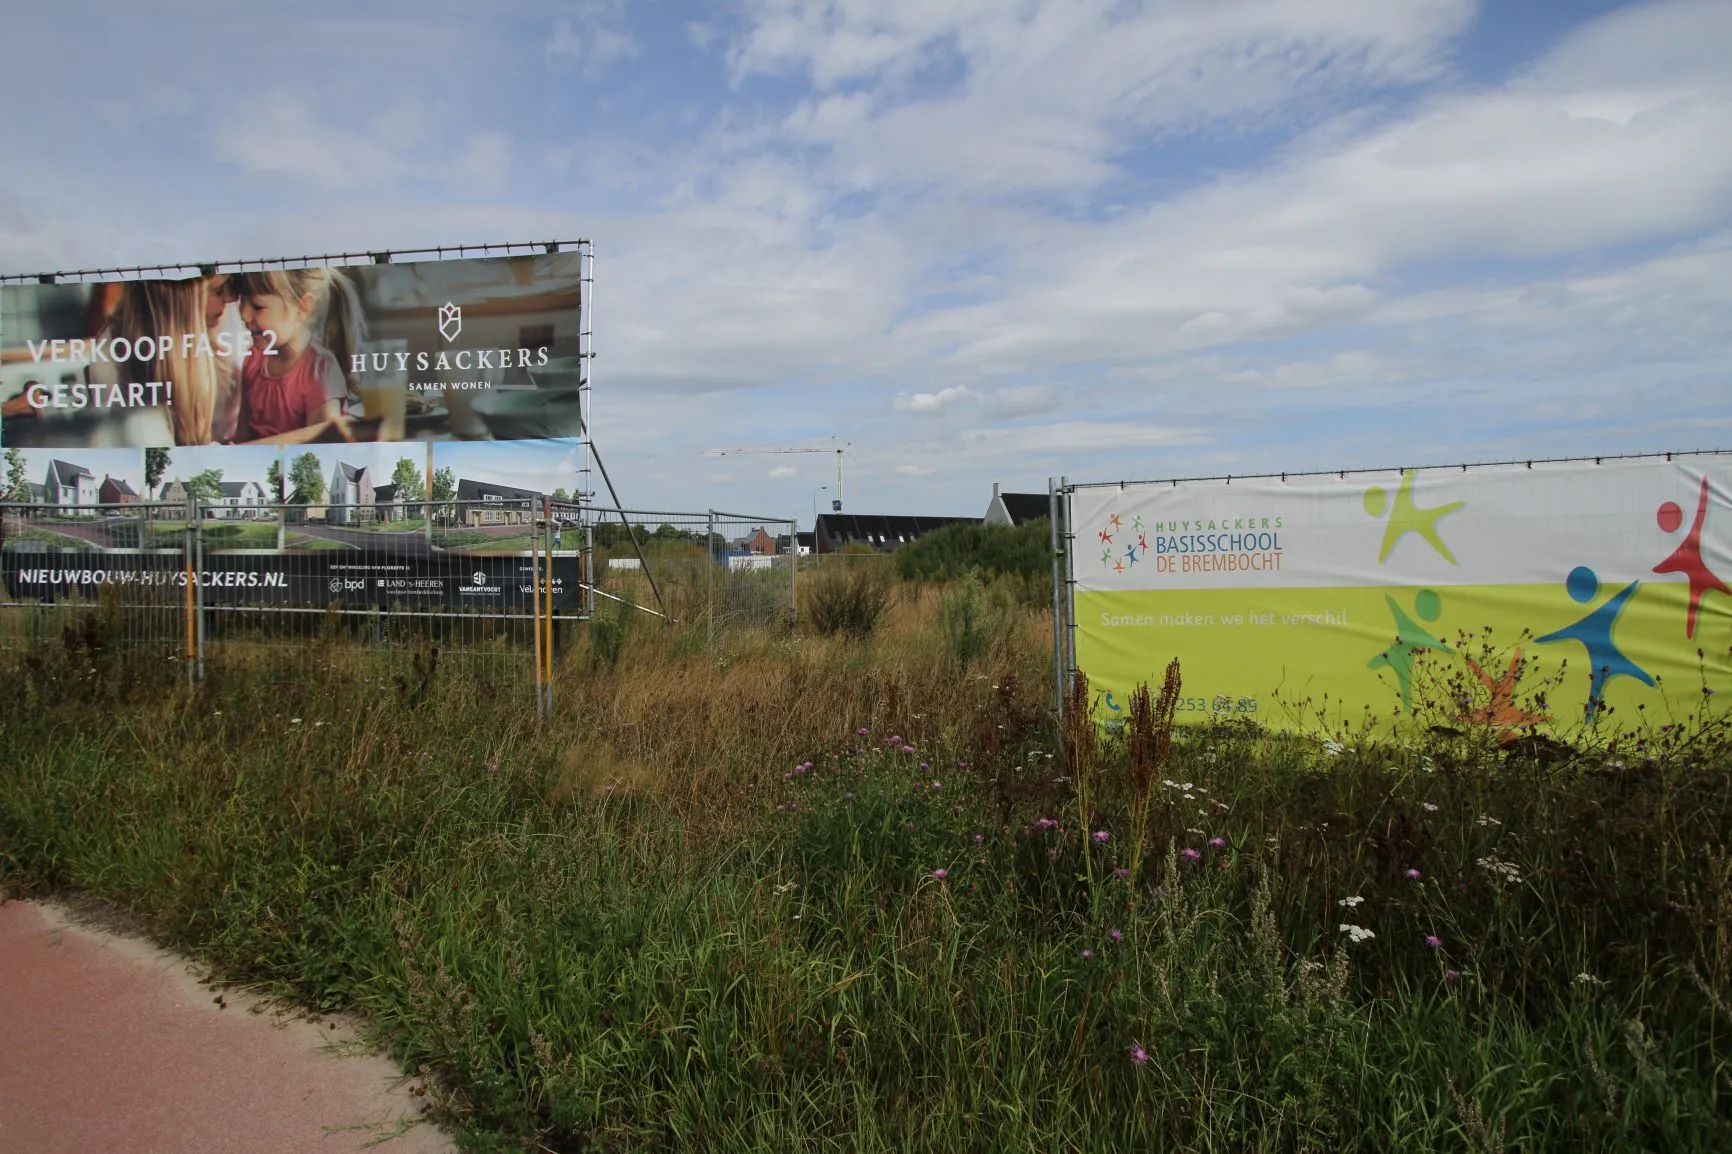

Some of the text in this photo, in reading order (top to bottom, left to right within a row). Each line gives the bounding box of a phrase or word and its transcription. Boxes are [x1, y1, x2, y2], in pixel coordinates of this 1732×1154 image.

[27, 330, 279, 363] VERKOOP FASE 2
[351, 346, 549, 373] HUYSACKERS
[27, 381, 173, 409] GESTART!
[409, 381, 491, 391] SAMEN WONEN
[1156, 517, 1283, 533] HUYSACKERS
[1156, 532, 1283, 554] BASISSCHOOL
[1157, 552, 1283, 573] DE BREMBOCHT
[344, 578, 365, 592] bpd
[386, 580, 406, 588] LAND
[1101, 608, 1348, 627] Samen maken we het verschil
[1177, 698, 1206, 712] 253
